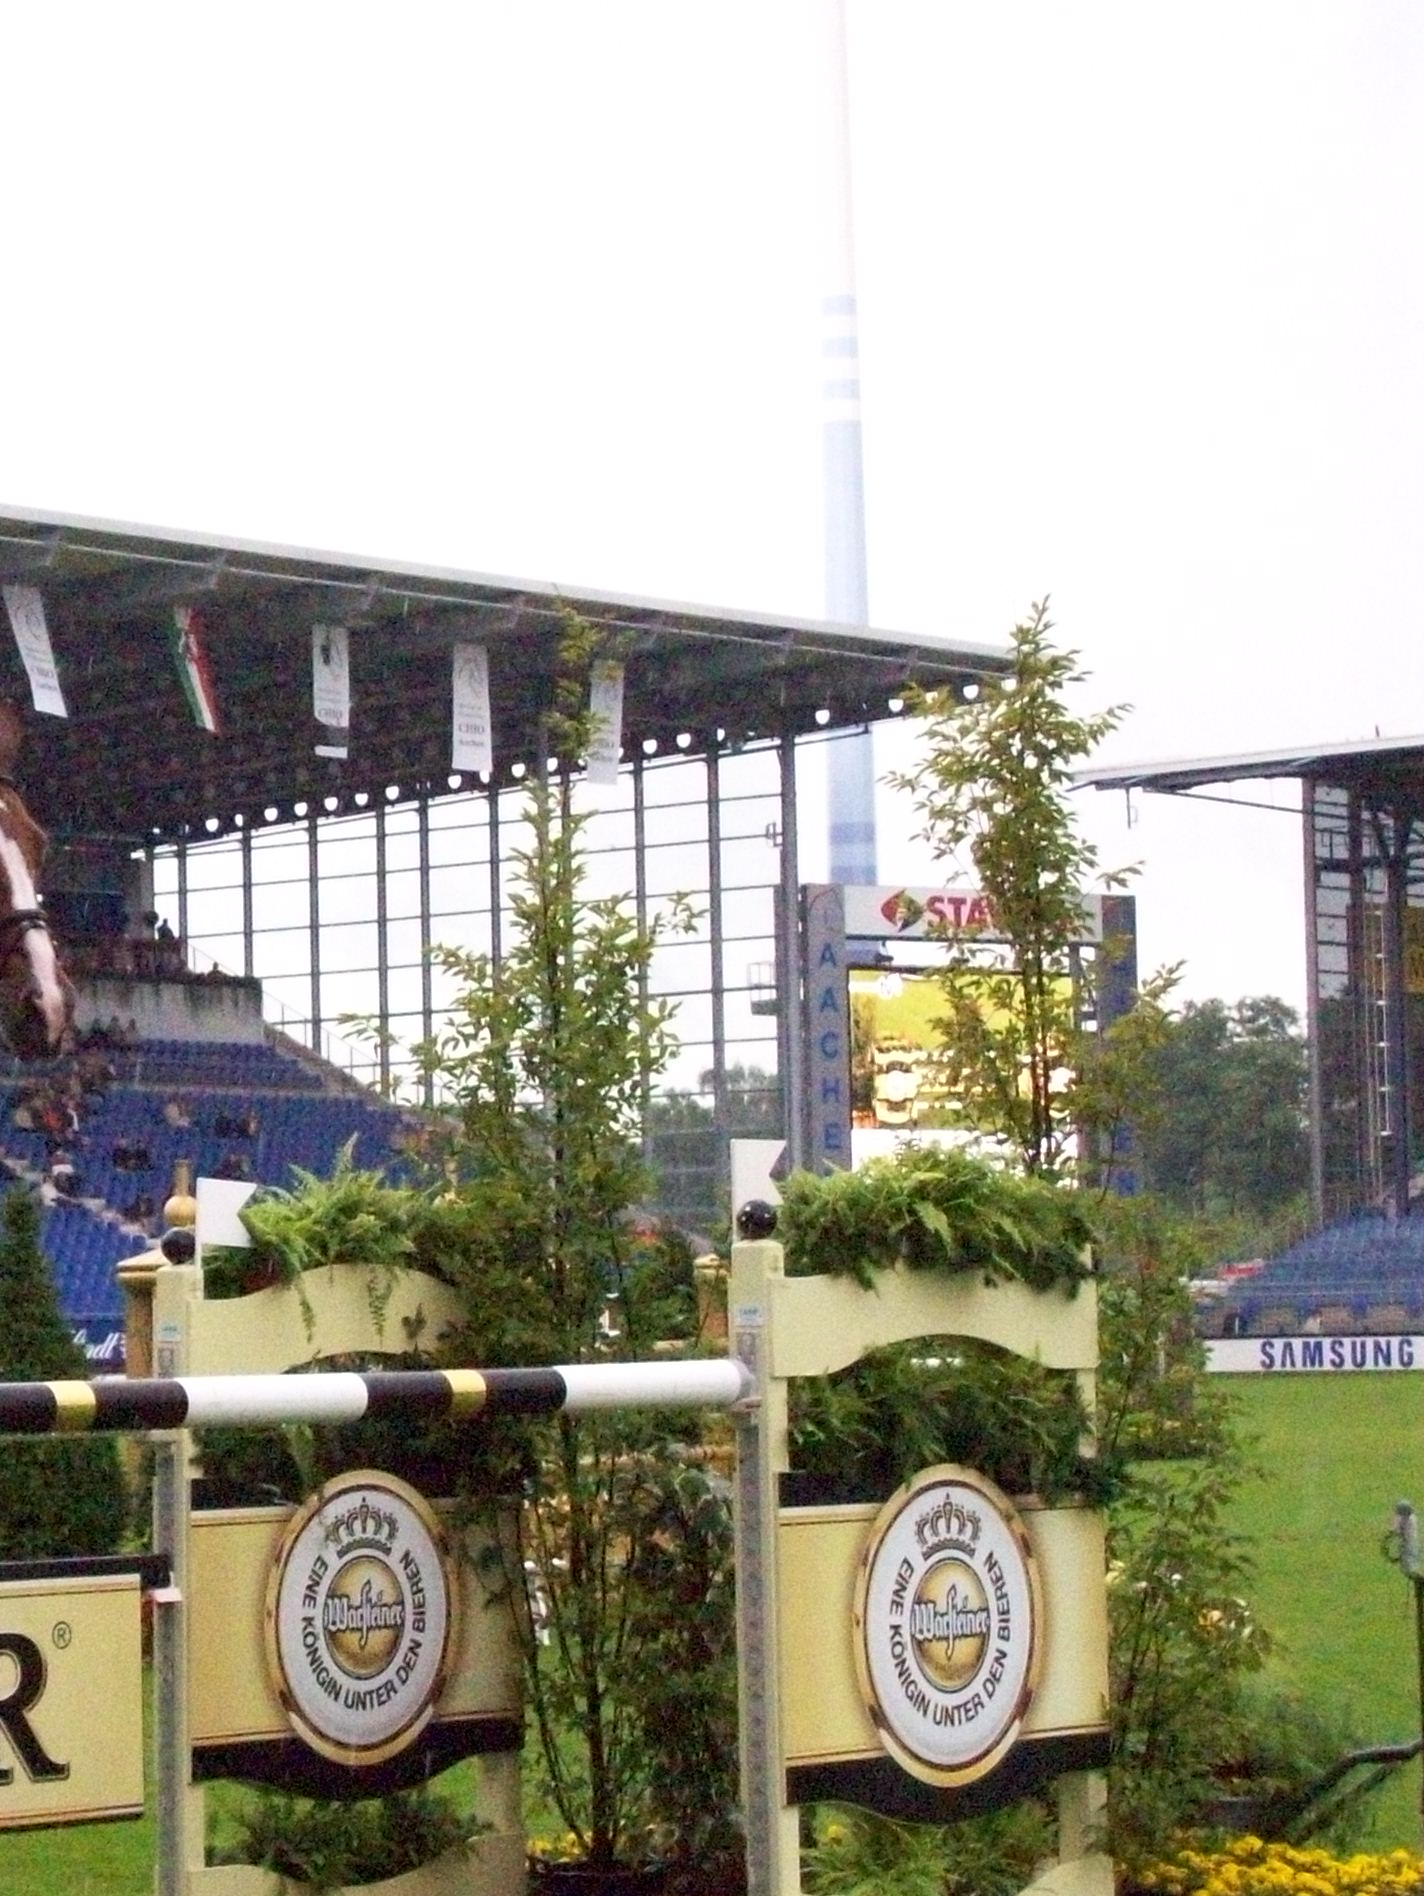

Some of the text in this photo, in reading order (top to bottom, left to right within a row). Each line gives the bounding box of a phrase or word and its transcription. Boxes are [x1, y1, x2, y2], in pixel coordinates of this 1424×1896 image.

[819, 942, 842, 1150] AACHE
[1260, 1338, 1414, 1369] SAMSUNG
[325, 1578, 405, 1650] Warsteiner
[889, 1556, 914, 1617] EINE
[910, 1583, 990, 1662] Warsteiner
[983, 1550, 1011, 1642] BIEREN
[301, 1549, 427, 1711] EINE KÖNIGIN UNTER DEN BIEREN
[889, 1624, 930, 1718] KÖNIGIN
[983, 1649, 1008, 1700] DEN
[933, 1692, 985, 1727] UNTER
